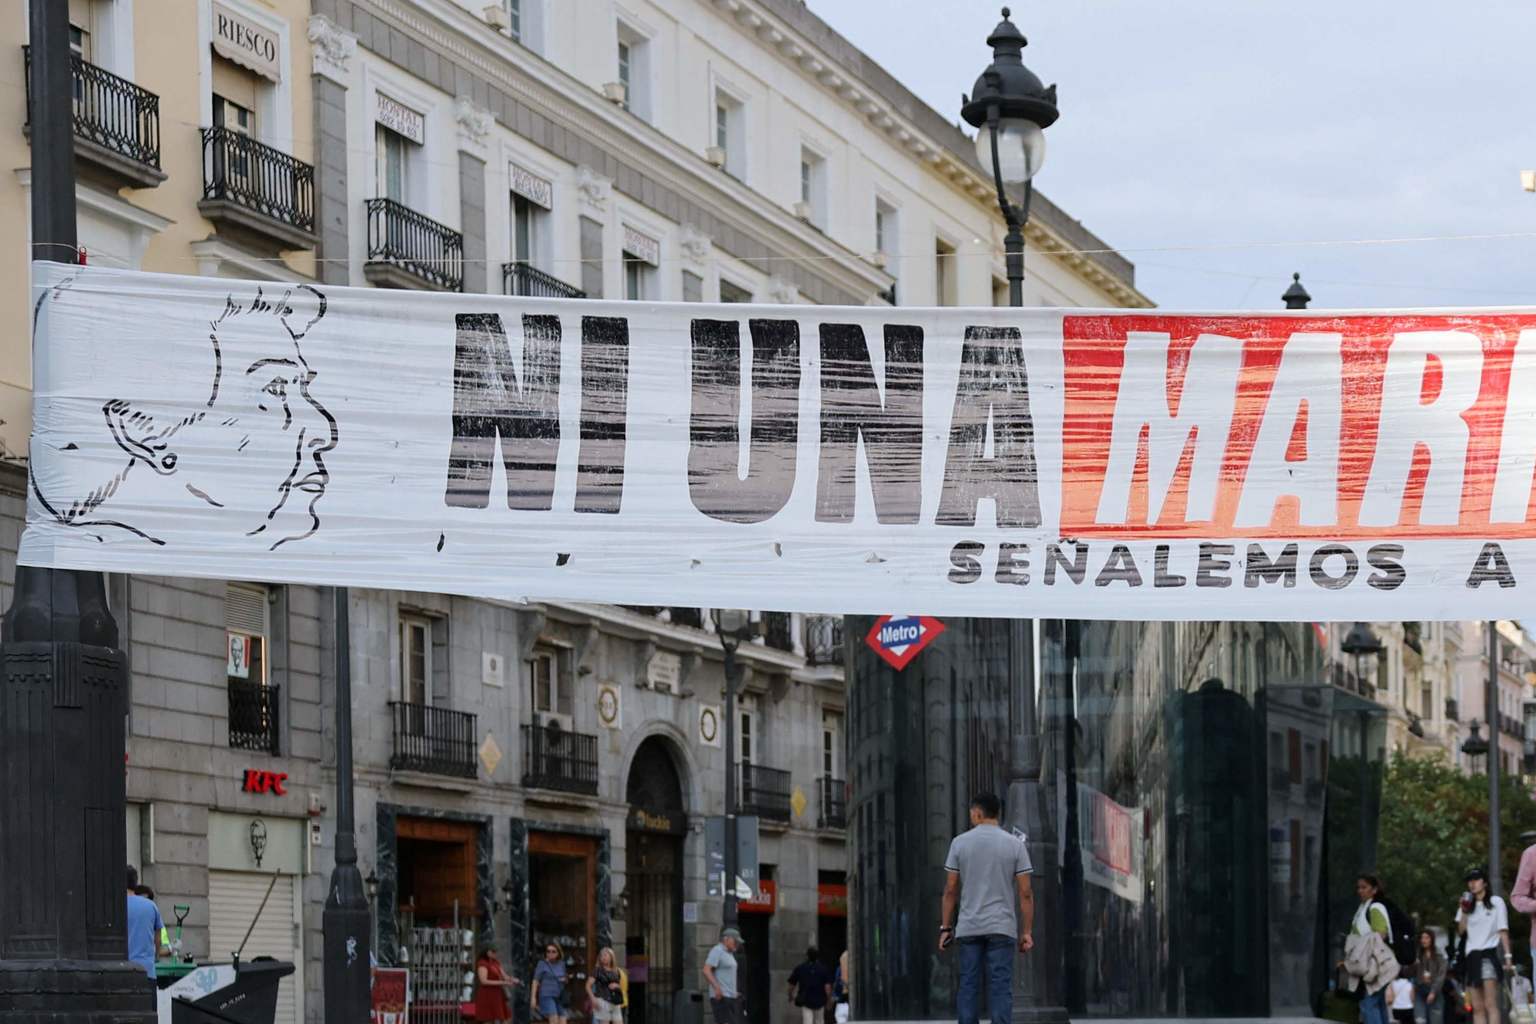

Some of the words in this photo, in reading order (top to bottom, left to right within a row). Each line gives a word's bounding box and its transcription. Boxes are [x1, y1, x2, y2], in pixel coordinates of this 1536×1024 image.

[218, 14, 275, 62] RIESCO
[445, 313, 629, 514] NI
[687, 319, 1042, 528] UNA
[947, 537, 1407, 591] SEÑALEMOS
[1466, 542, 1516, 589] A
[882, 624, 918, 644] Metro
[244, 769, 288, 796] KFC
